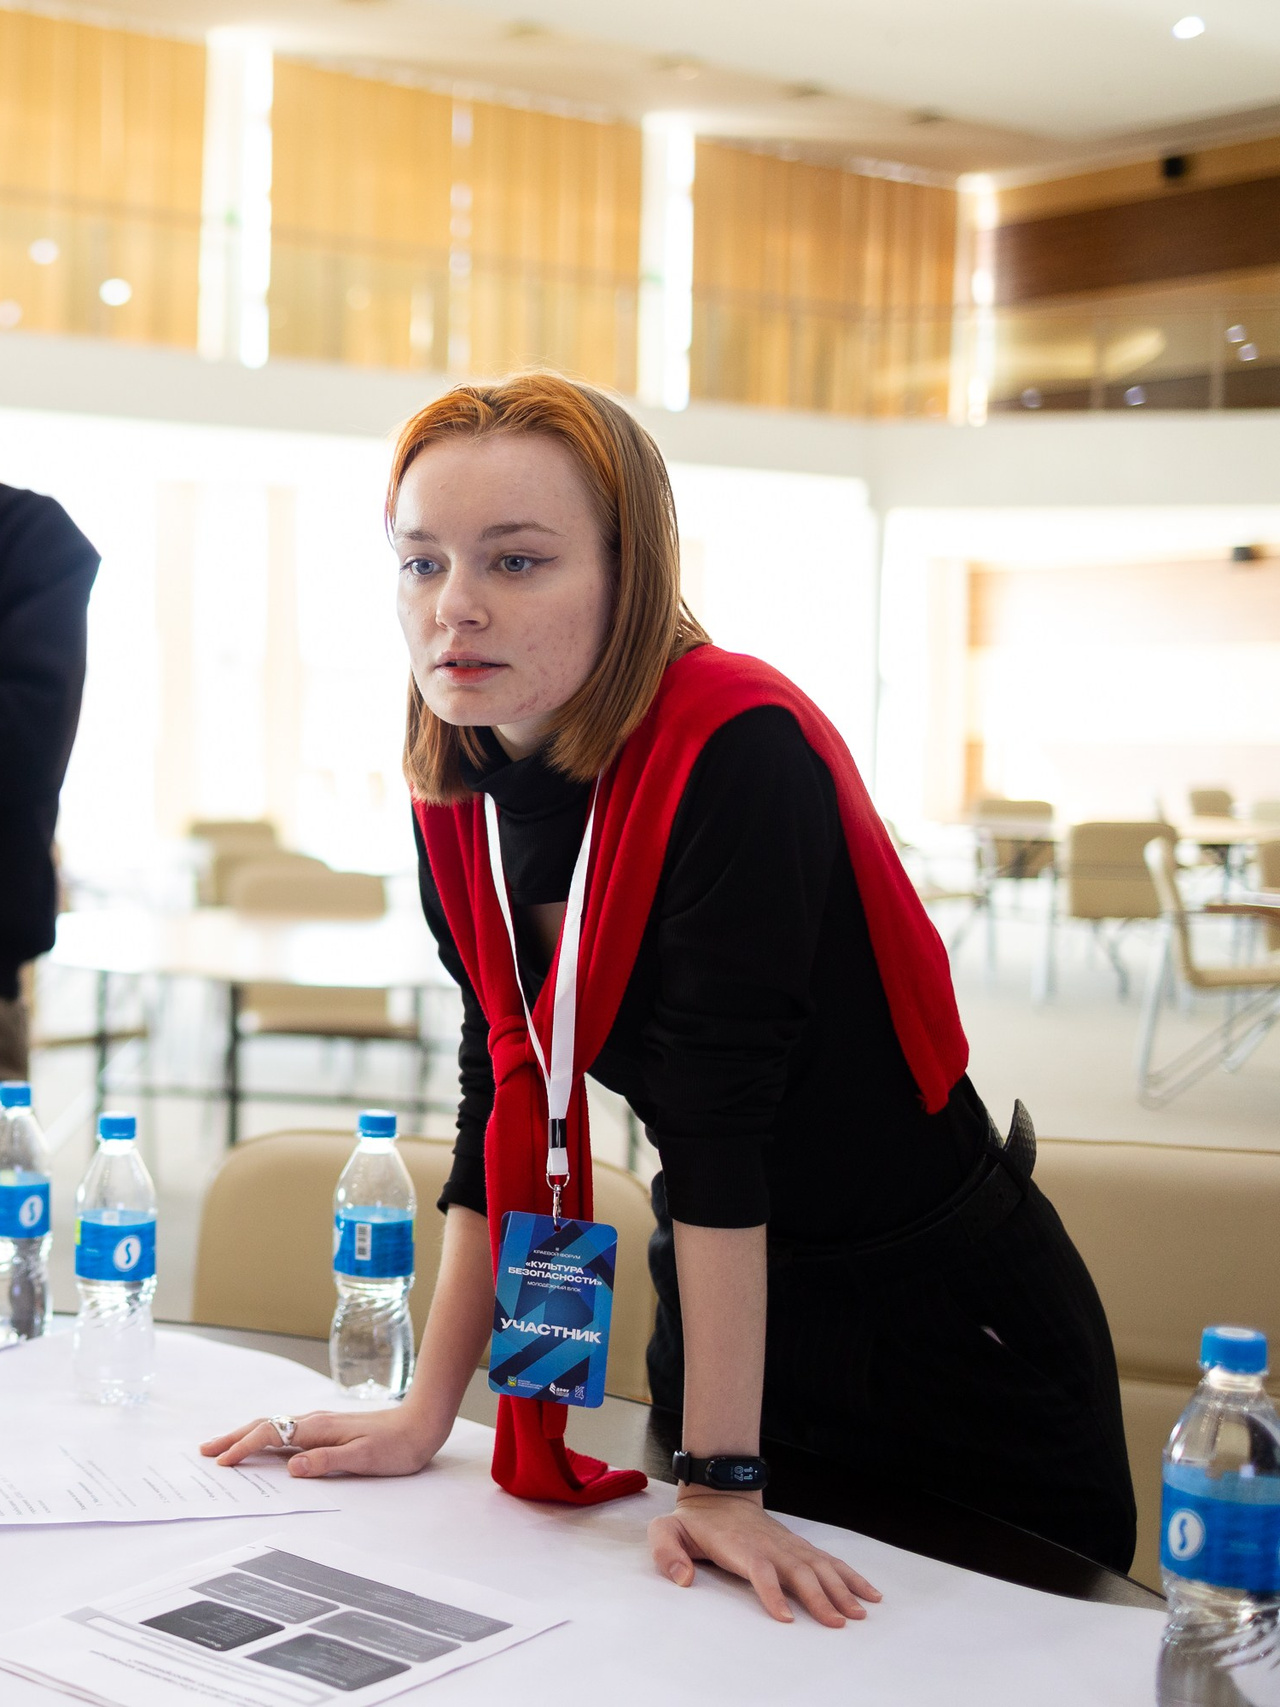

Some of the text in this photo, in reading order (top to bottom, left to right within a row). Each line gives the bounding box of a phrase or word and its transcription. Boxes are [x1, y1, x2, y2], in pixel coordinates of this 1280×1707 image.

[533, 1249, 581, 1260] КРАЕВОЙ ФОРУМ
[508, 1266, 603, 1286] БЕЗОПАСНОСТИ»
[525, 1260, 584, 1275] «КУЛЬТУРА
[500, 1317, 602, 1344] УЧАСТНИК
